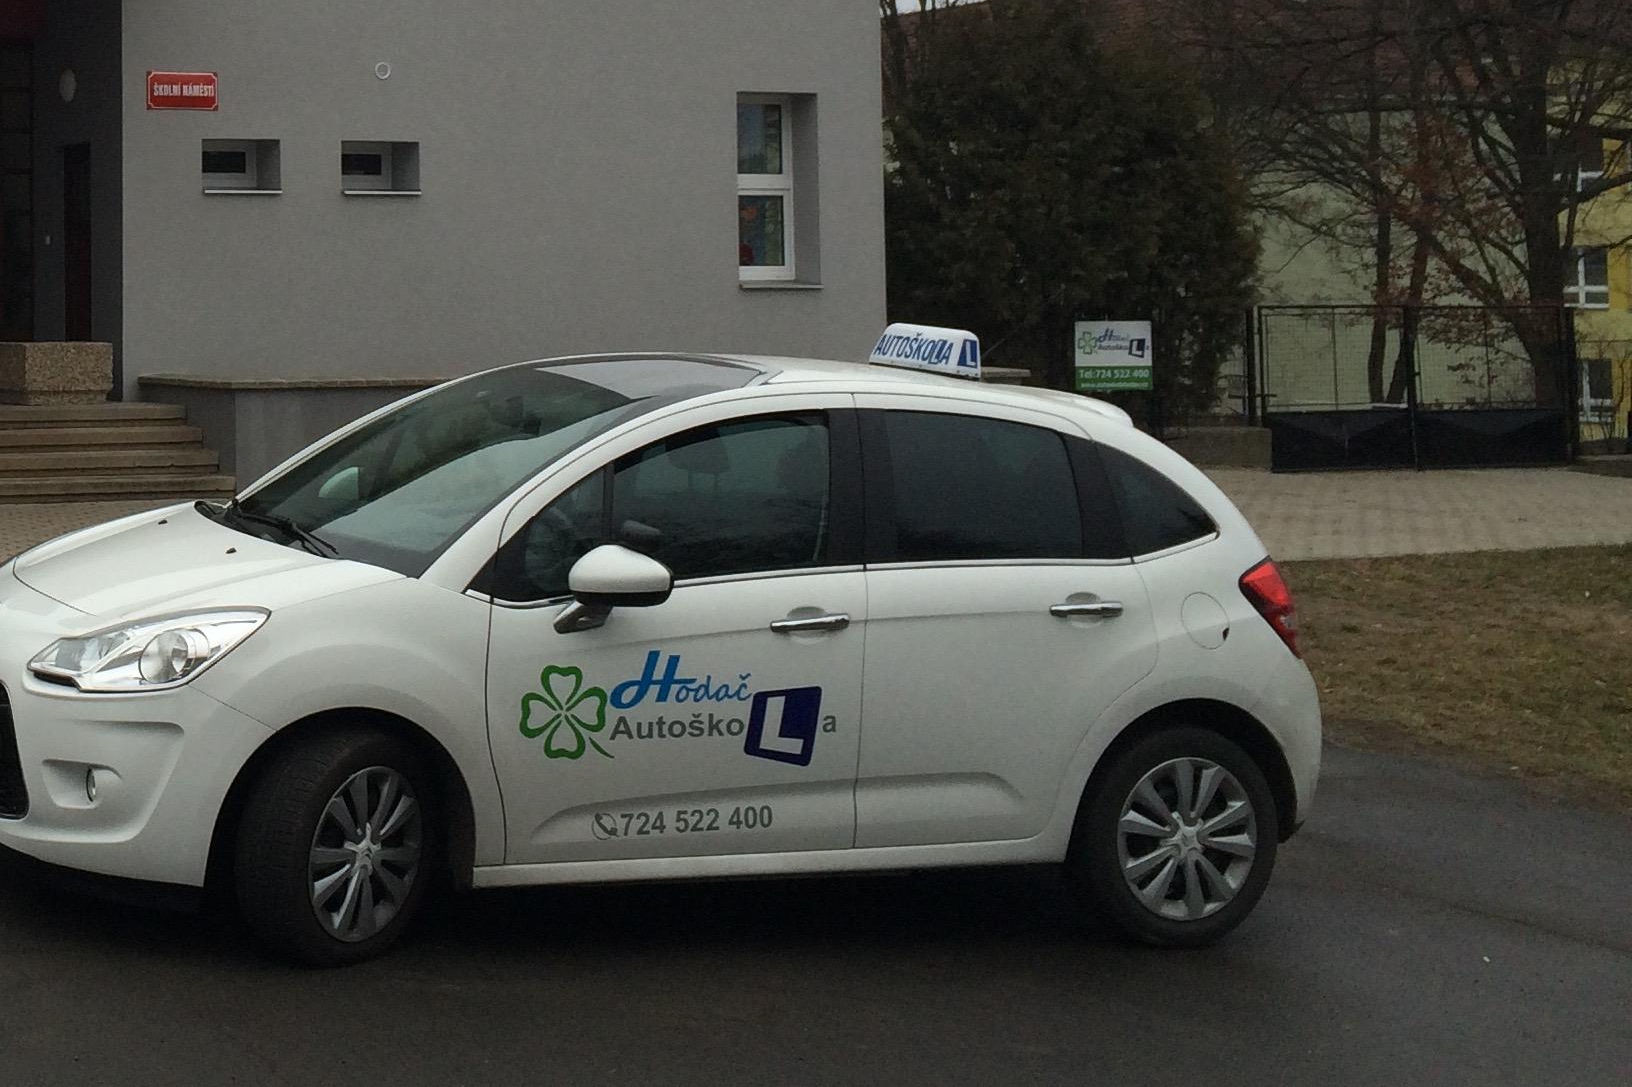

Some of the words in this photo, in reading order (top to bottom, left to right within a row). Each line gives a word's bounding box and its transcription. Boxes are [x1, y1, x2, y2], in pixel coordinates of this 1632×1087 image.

[153, 82, 181, 97] ŠKOLNÍ
[873, 333, 954, 365] AUTOŠKOLA
[1113, 369, 1131, 378] 522
[610, 650, 752, 709] Hodač
[621, 811, 666, 836] 724
[675, 808, 720, 833] 522
[728, 805, 773, 829] 400
